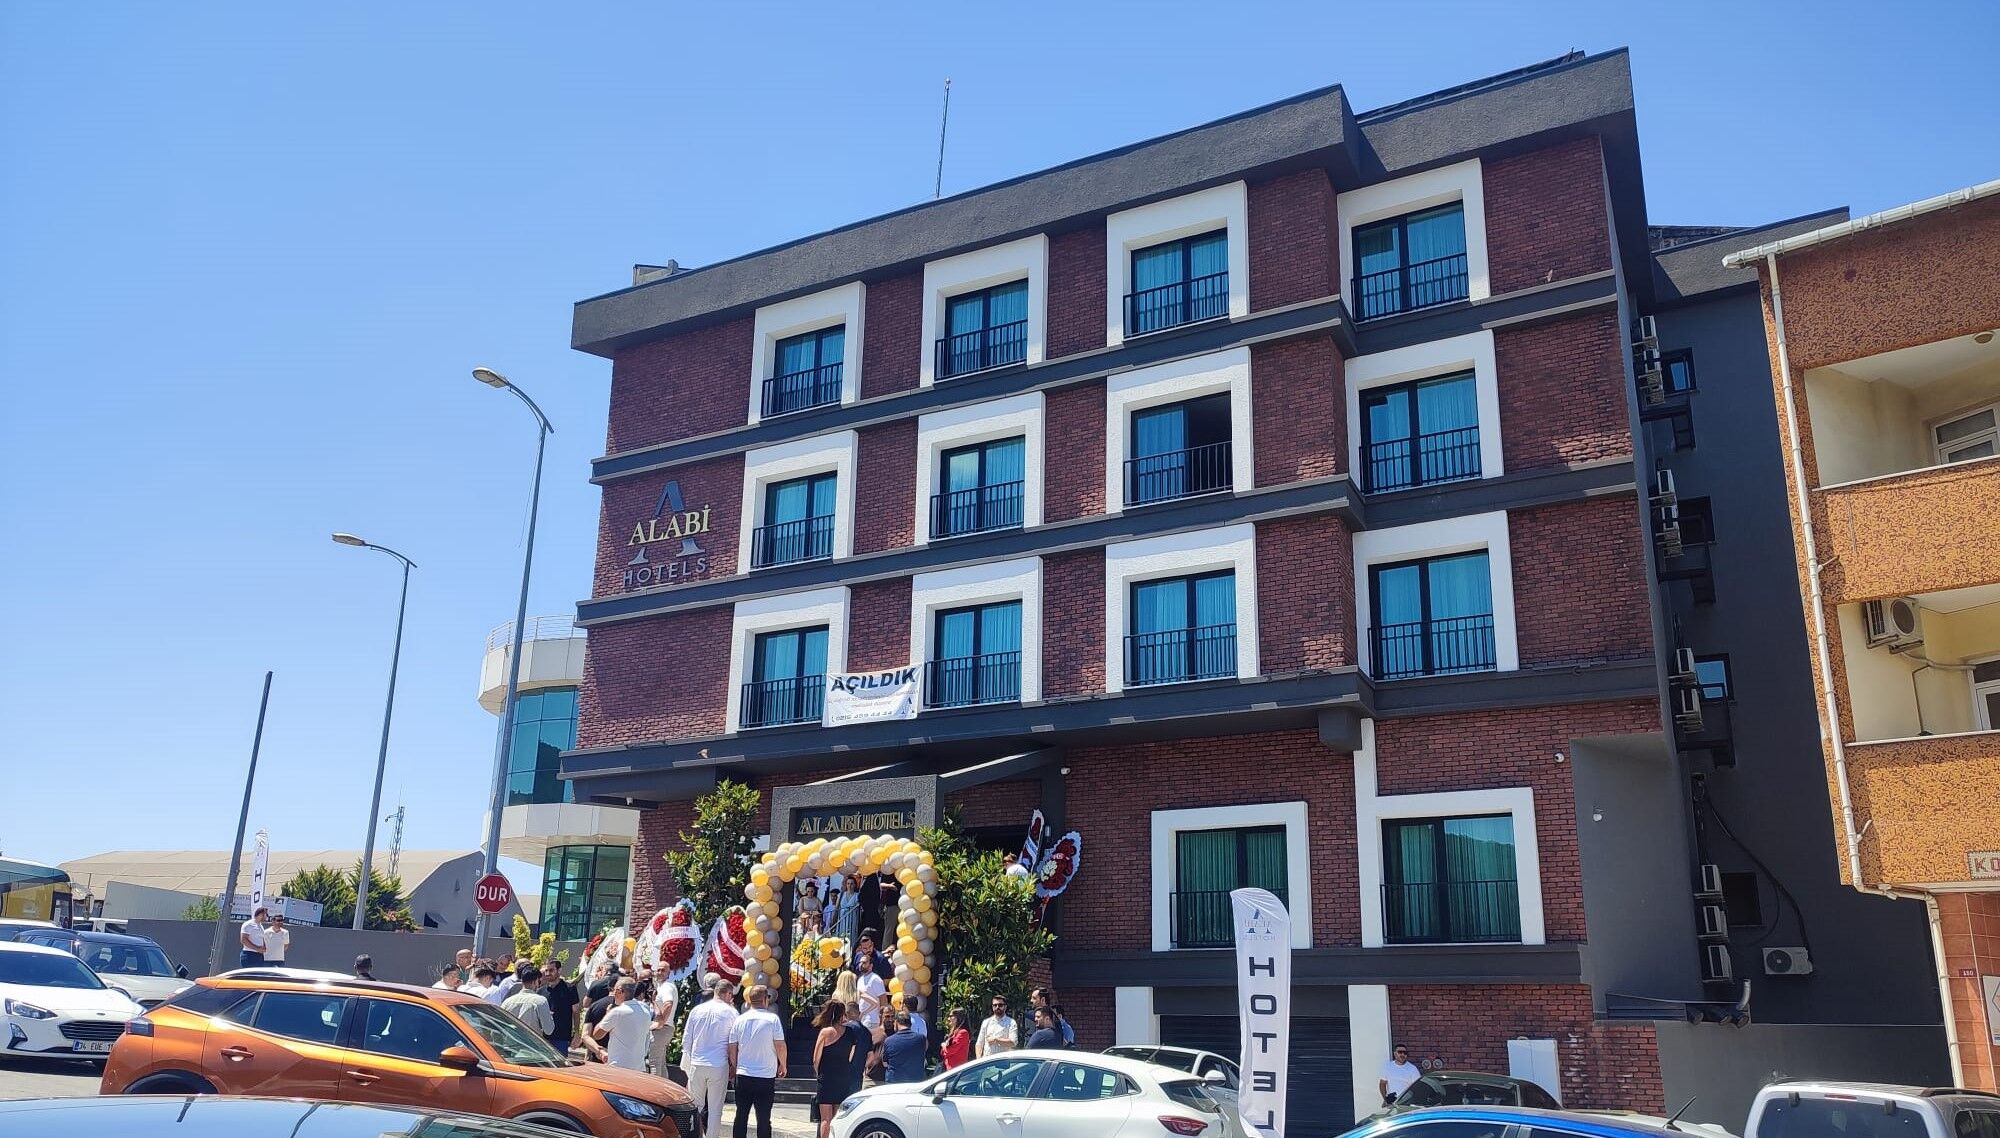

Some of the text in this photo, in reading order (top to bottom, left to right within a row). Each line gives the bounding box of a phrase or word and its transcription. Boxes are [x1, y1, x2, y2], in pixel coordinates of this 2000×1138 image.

[627, 504, 712, 546] ALABİ
[623, 557, 707, 587] HOTELS
[831, 667, 916, 695] AÇILDIK
[796, 811, 916, 835] ALABİ HOTELS
[477, 885, 508, 902] DUR
